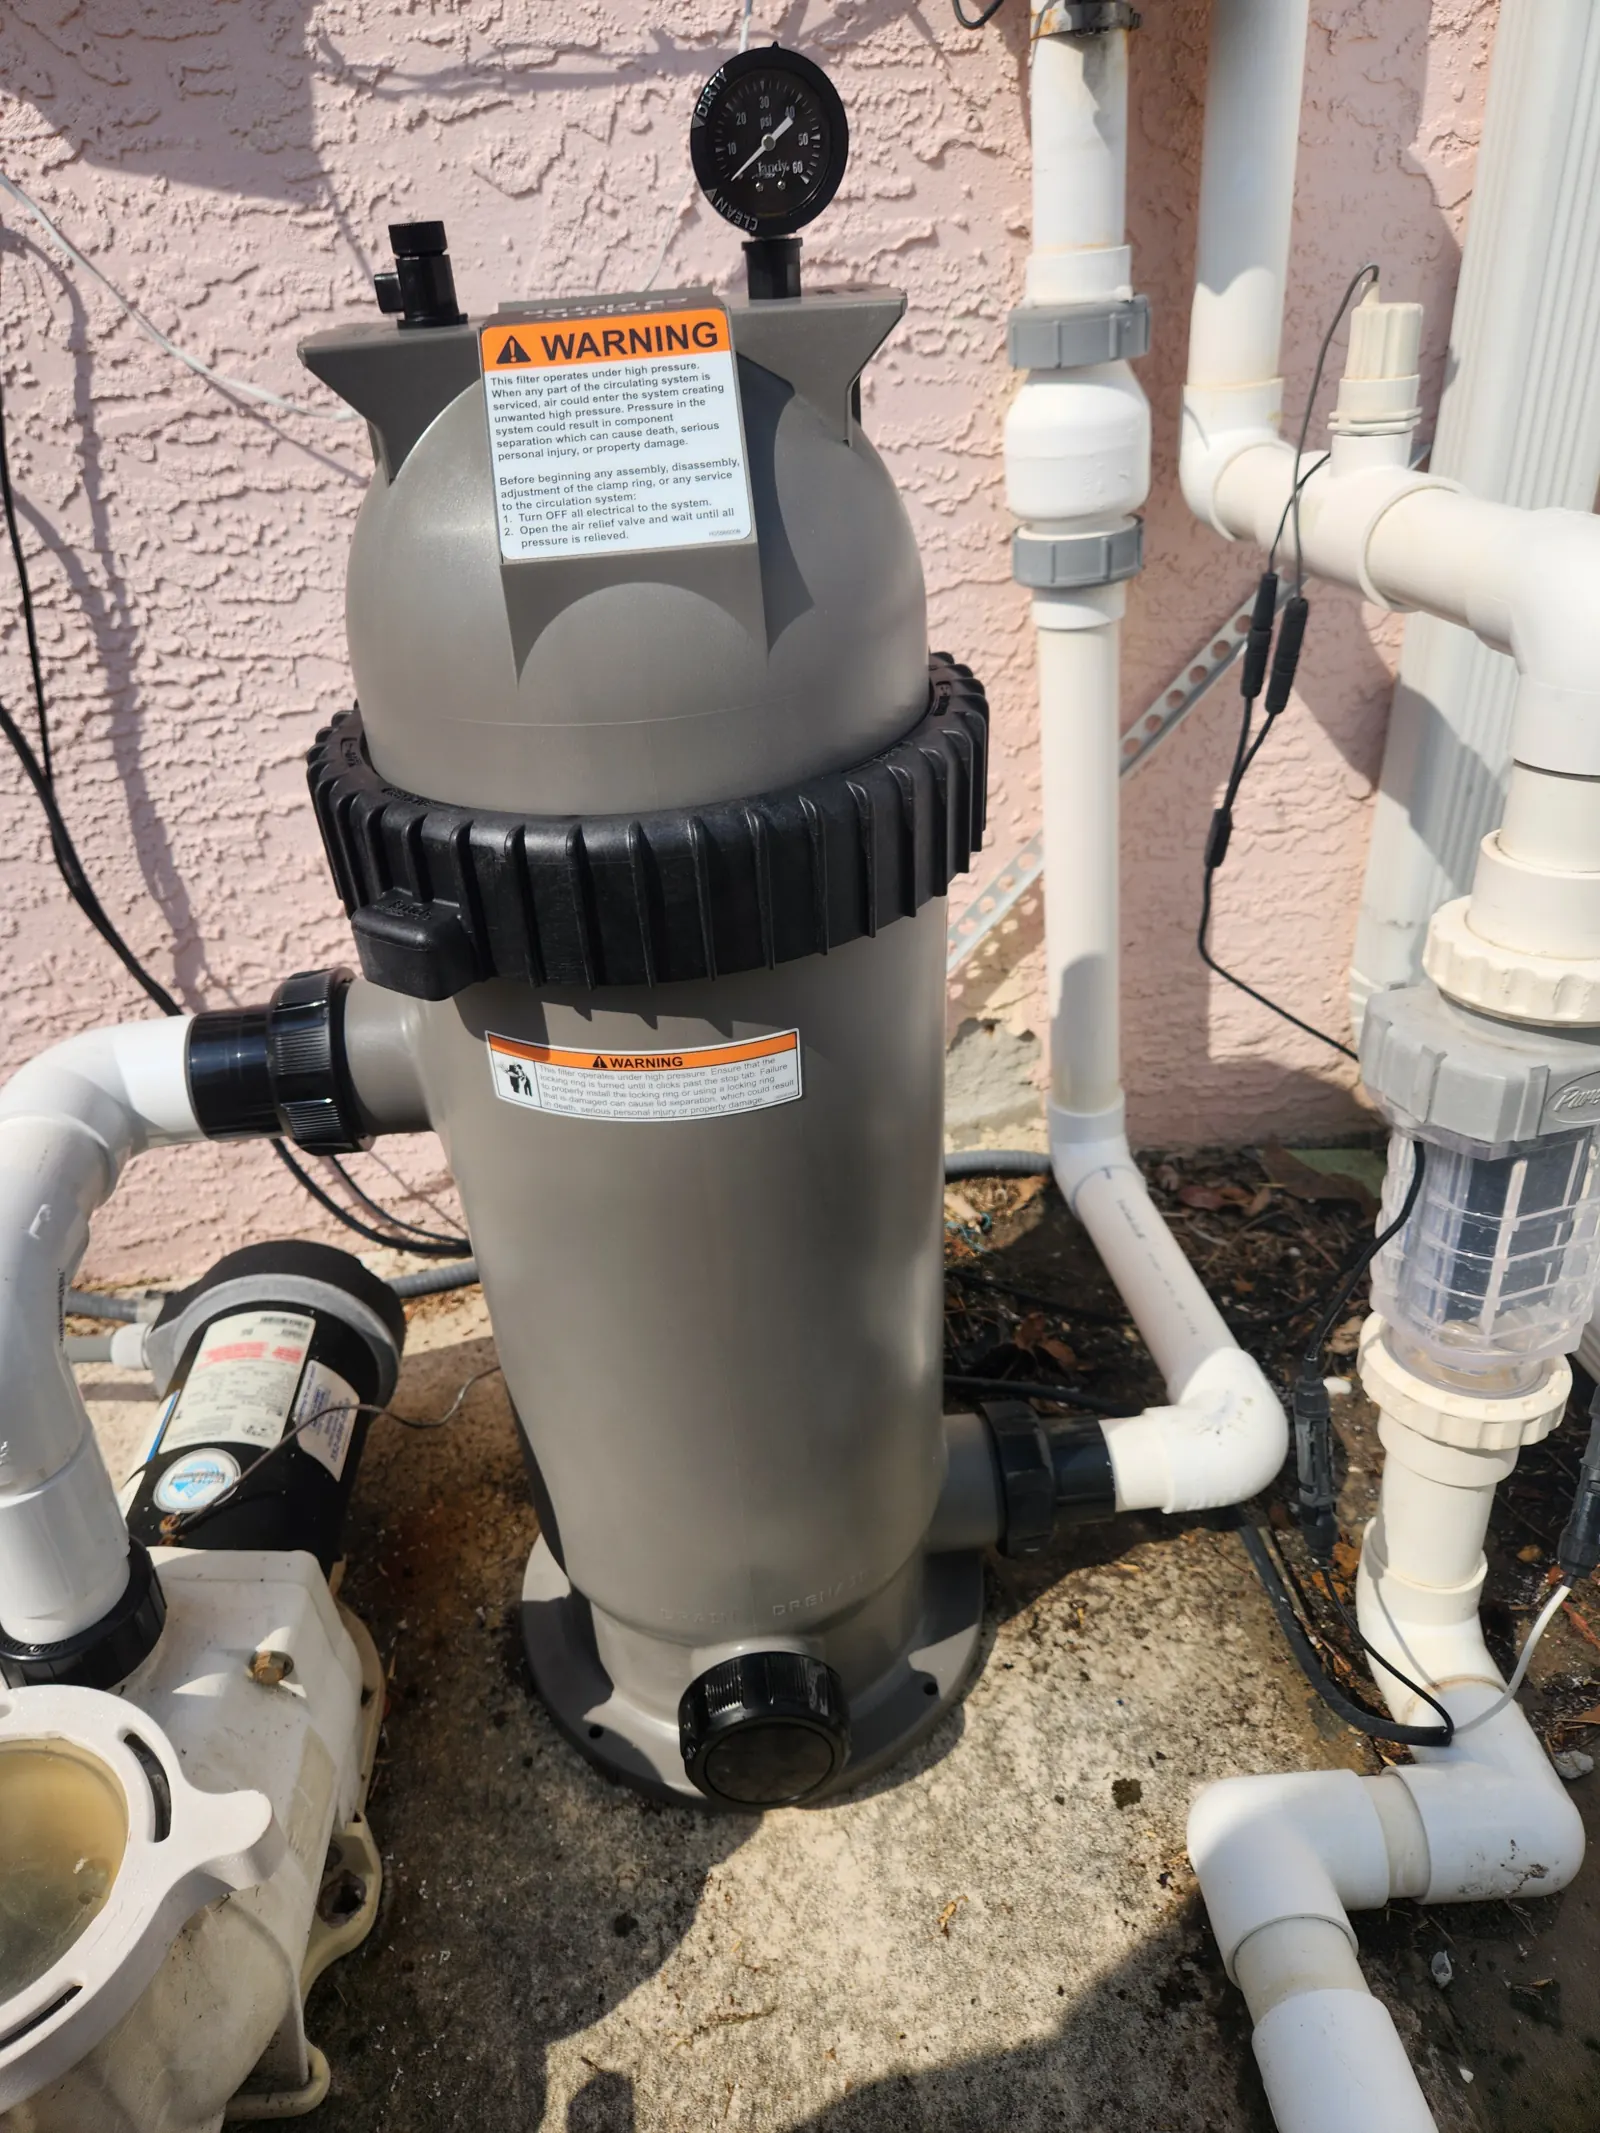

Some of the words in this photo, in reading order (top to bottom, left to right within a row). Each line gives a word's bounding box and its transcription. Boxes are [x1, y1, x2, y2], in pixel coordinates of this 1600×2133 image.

[697, 67, 727, 118] DIRTY
[759, 96, 769, 109] 30
[736, 112, 746, 125] 20
[760, 116, 772, 130] psi
[785, 106, 795, 118] 40
[728, 143, 736, 155] 10
[799, 133, 809, 146] 50
[793, 161, 803, 174] 60
[716, 197, 758, 231] CLEAN
[541, 322, 718, 360] WARNING
[490, 377, 513, 386] This
[517, 376, 540, 384] filter
[543, 372, 588, 383] operates
[592, 368, 621, 378] under
[625, 366, 647, 376] high
[651, 363, 699, 374] pressure.
[492, 389, 521, 398] When
[525, 388, 543, 397] any
[547, 385, 567, 396] part
[571, 384, 580, 392] of
[584, 383, 599, 391] the
[604, 379, 658, 389] circulating
[661, 376, 698, 386] system
[493, 400, 540, 411] serviced,
[544, 398, 557, 407] air
[561, 396, 589, 405] could
[593, 394, 618, 402] enter
[622, 392, 638, 400] the
[642, 389, 679, 400] system
[682, 384, 724, 394] creating
[494, 412, 545, 423] unwanted
[549, 410, 571, 420] high
[575, 406, 624, 418] pressure.
[627, 404, 673, 412] Pressure
[677, 400, 686, 408] in
[690, 398, 706, 406] the
[496, 426, 533, 437] system
[537, 423, 566, 432] could
[569, 420, 599, 429] result
[602, 419, 611, 427] in
[615, 414, 673, 425] component
[497, 437, 552, 448] separation
[556, 433, 586, 443] which
[590, 432, 608, 440] can
[612, 429, 642, 439] cause
[646, 426, 677, 436] death,
[681, 423, 719, 433] serious
[498, 449, 543, 461] personal
[547, 446, 579, 457] injury,
[597, 442, 640, 454] property
[644, 439, 688, 448] damage.
[500, 476, 534, 485] Before
[538, 472, 591, 483] beginning
[594, 470, 613, 478] any
[617, 465, 668, 476] assembly,
[672, 458, 740, 471] disassembly,
[501, 487, 560, 499] adjustment
[564, 485, 574, 493] of
[577, 484, 593, 492] the
[597, 481, 628, 491] clamp
[632, 480, 655, 488] ring,
[673, 476, 691, 485] any
[695, 473, 732, 482] service
[502, 503, 512, 511] to
[516, 501, 532, 510] the
[536, 497, 591, 508] circulation
[595, 494, 636, 504] system:
[504, 515, 512, 523] 1.
[519, 513, 542, 522] Turn
[546, 510, 567, 520] OFF
[571, 509, 583, 518] all
[587, 504, 634, 516] electrical
[638, 504, 648, 512] to
[652, 503, 667, 511] the
[671, 500, 712, 511] system.
[504, 528, 514, 536] 2.
[520, 526, 548, 536] Open
[552, 524, 568, 532] the
[572, 522, 584, 530] air
[589, 519, 614, 529] relief
[618, 517, 645, 526] valve
[649, 515, 667, 523] and
[671, 513, 692, 522] wait
[696, 510, 718, 519] until
[722, 508, 734, 517] all
[521, 537, 568, 549] pressure
[584, 531, 628, 542] relieved.
[610, 1056, 682, 1068] WARNING
